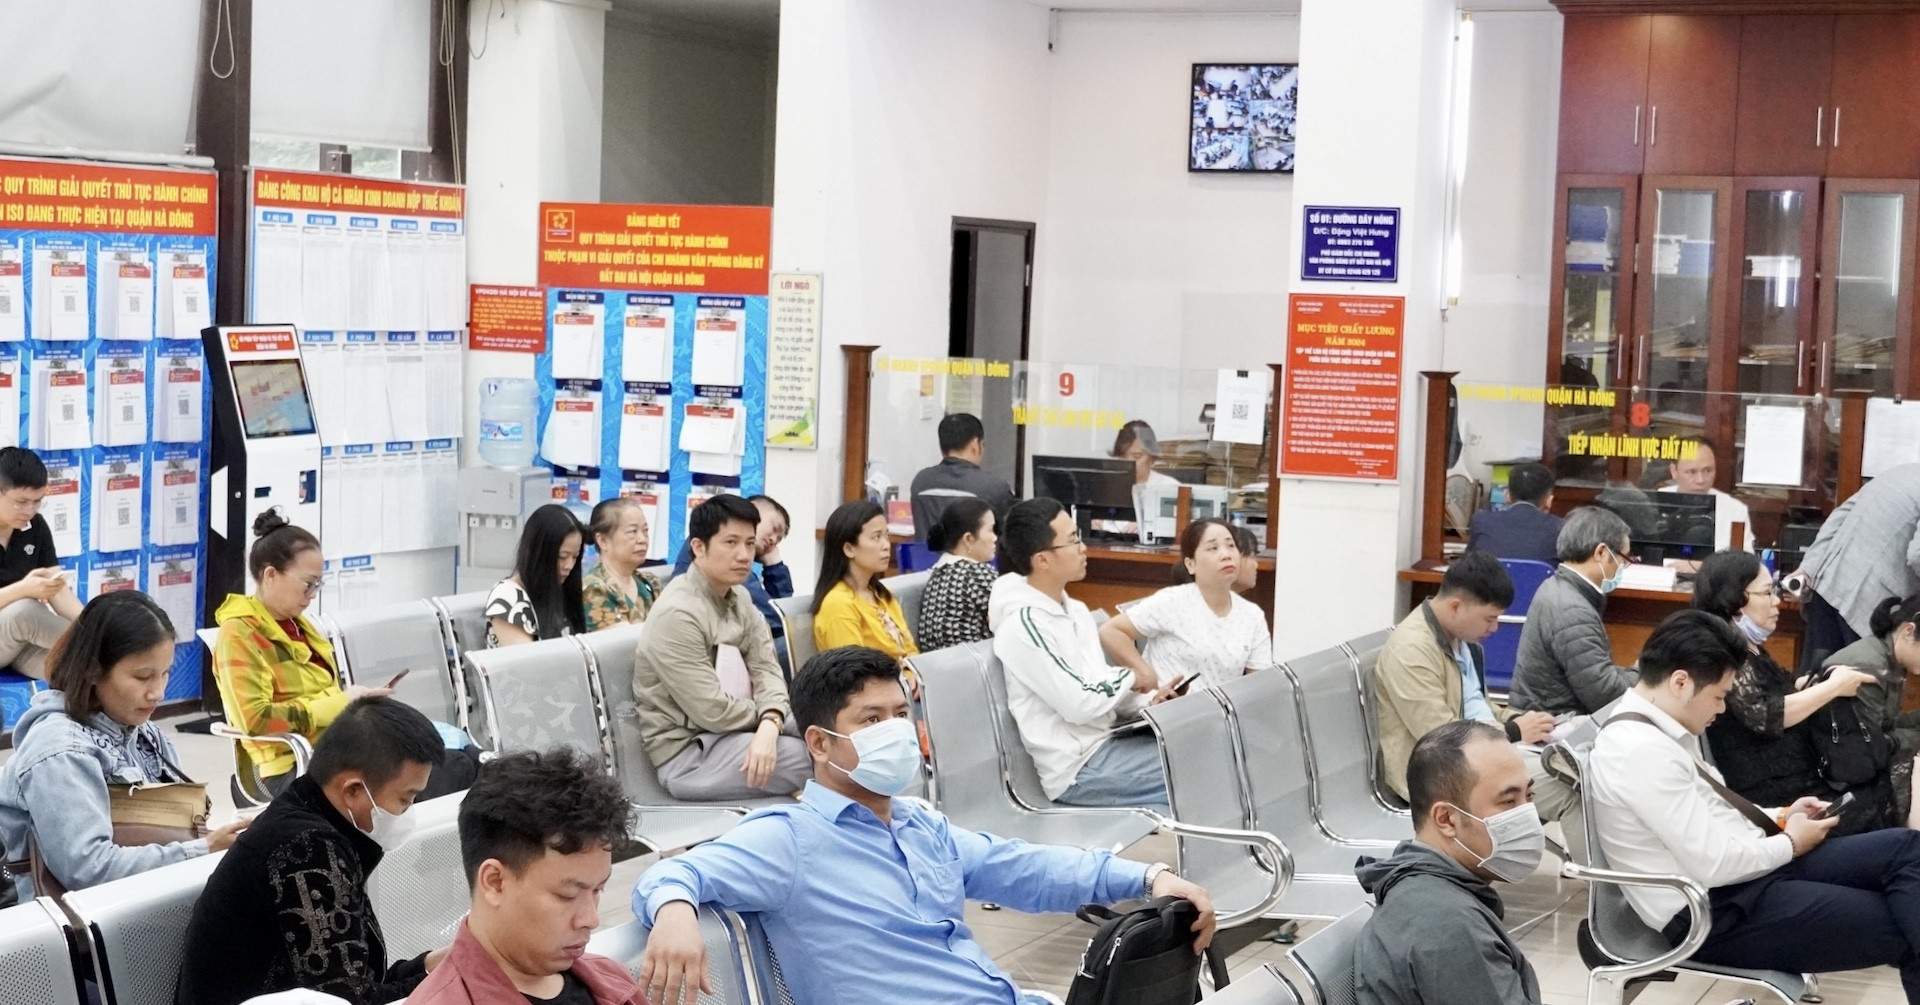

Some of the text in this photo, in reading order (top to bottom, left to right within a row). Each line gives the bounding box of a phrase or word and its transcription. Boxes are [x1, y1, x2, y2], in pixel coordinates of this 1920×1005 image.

[4, 173, 208, 204] QUY TRÌNH GIẢI QUYẾT THỦ TỤC HÀNH CHÍNH
[6, 203, 24, 221] ISO
[26, 204, 54, 223] ĐANG
[56, 205, 82, 227] THỰC
[84, 204, 107, 228] HIỆN
[109, 208, 124, 229] TẠI
[126, 206, 152, 230] QUẬN
[154, 207, 167, 227] HÀ
[169, 208, 194, 228] ĐÔNG
[1297, 324, 1316, 334] MỤC
[1318, 323, 1338, 333] TIÊU
[1340, 323, 1364, 335] CHẤT
[1059, 373, 1074, 396] 9
[1547, 386, 1572, 407] QUẬN
[1574, 386, 1587, 405] HÀ
[1589, 388, 1615, 407] ĐÔNG
[1631, 402, 1649, 427] 8
[1568, 430, 1588, 455] TIẾP
[1590, 432, 1616, 460] NHẬN
[1618, 433, 1639, 458] LĨNH
[1641, 436, 1660, 462] VỰC
[1661, 434, 1680, 460] ĐẤT
